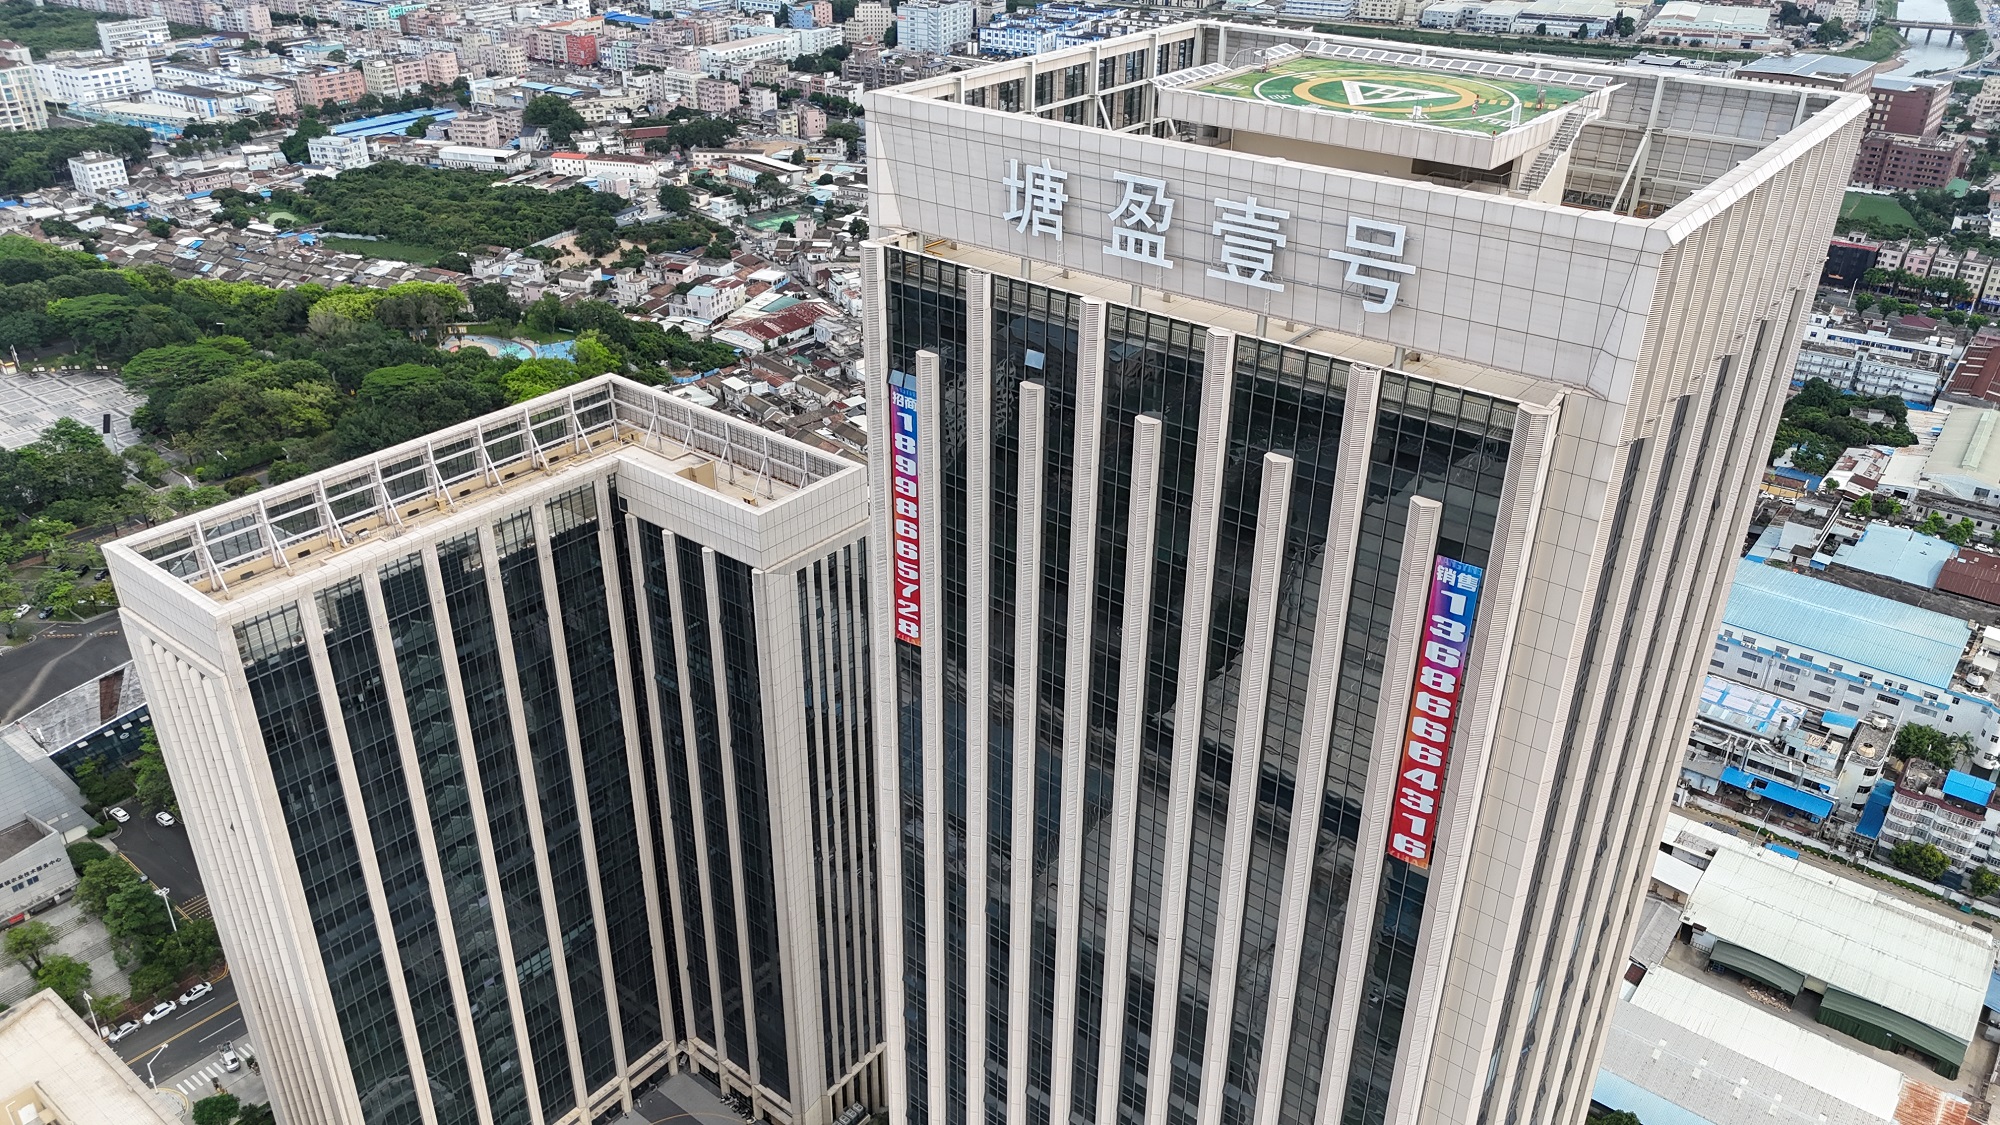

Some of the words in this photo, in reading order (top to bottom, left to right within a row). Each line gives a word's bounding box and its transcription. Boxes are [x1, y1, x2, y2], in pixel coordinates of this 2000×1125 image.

[1002, 157, 1416, 314] 塘盈壹号
[892, 391, 917, 412] 招商
[894, 411, 919, 638] 18998665728
[1436, 565, 1479, 592] 销售
[1393, 590, 1466, 858] 13686664316
